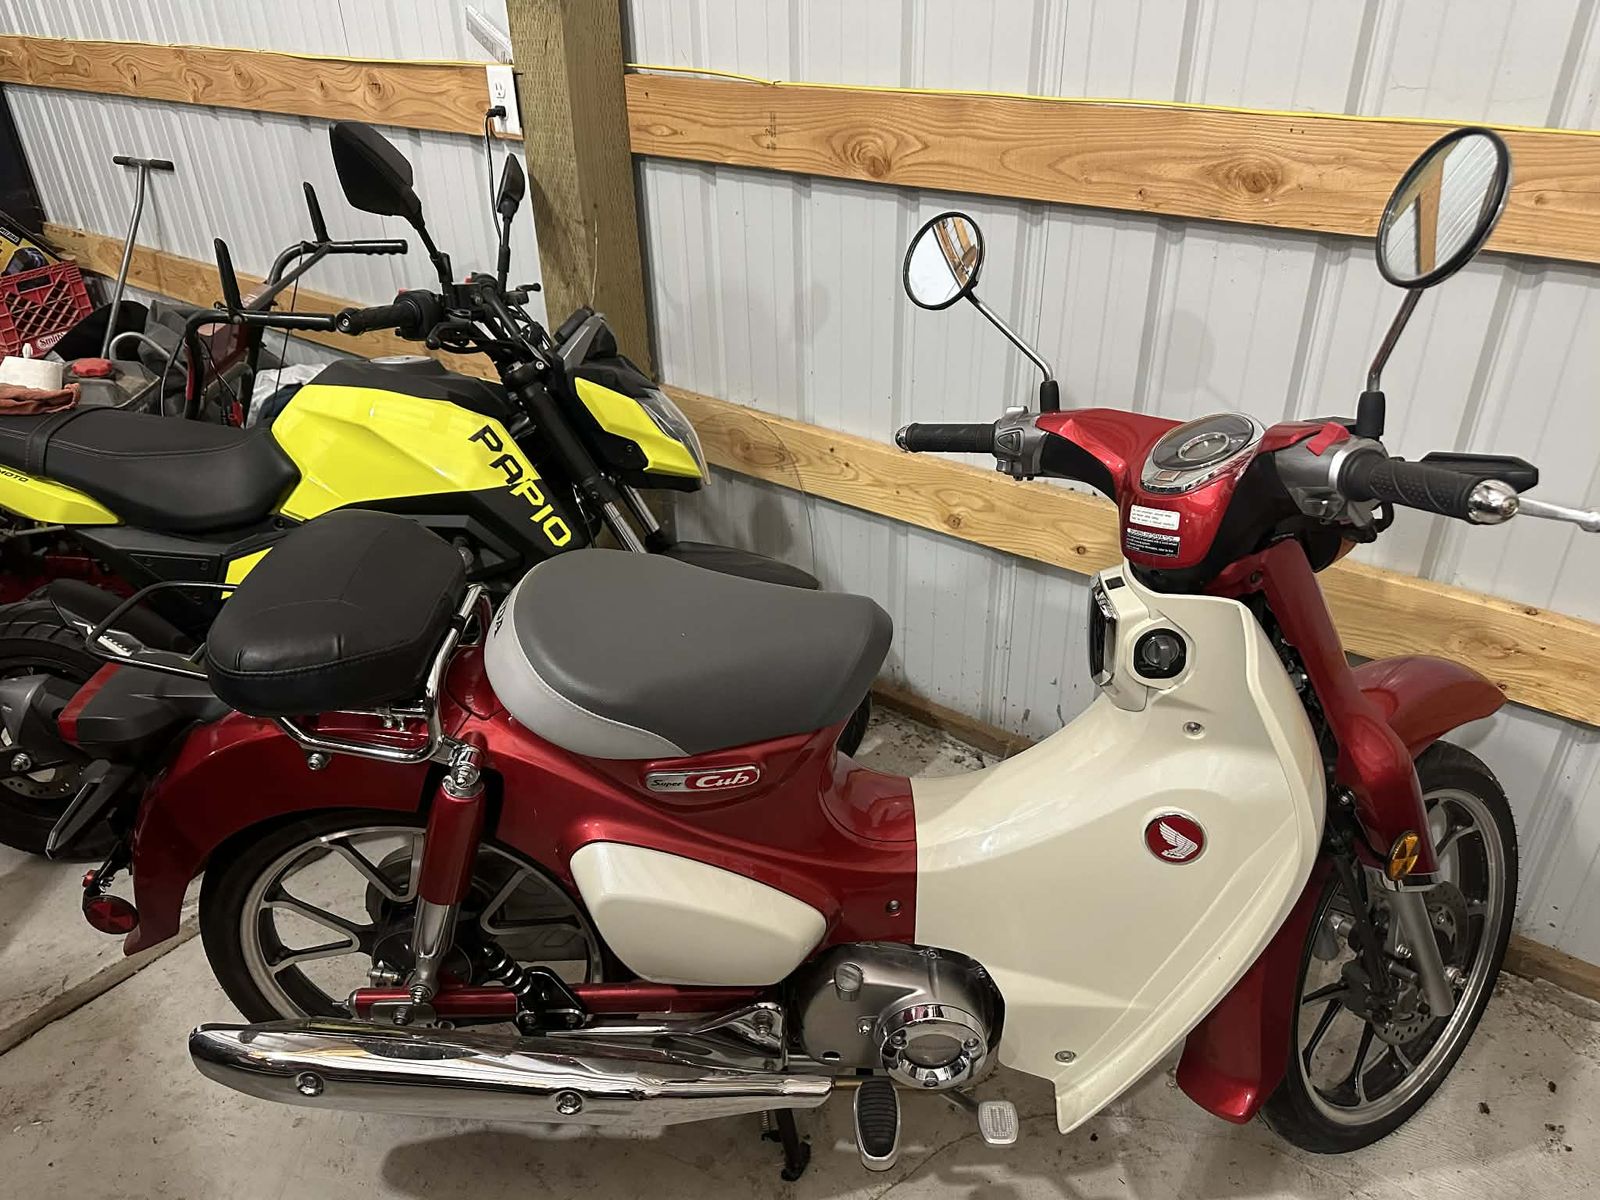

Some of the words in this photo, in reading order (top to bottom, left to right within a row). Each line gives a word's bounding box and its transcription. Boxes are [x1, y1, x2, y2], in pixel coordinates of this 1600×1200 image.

[467, 424, 572, 547] PAPIO
[650, 779, 682, 788] Super
[696, 772, 750, 787] Cub
